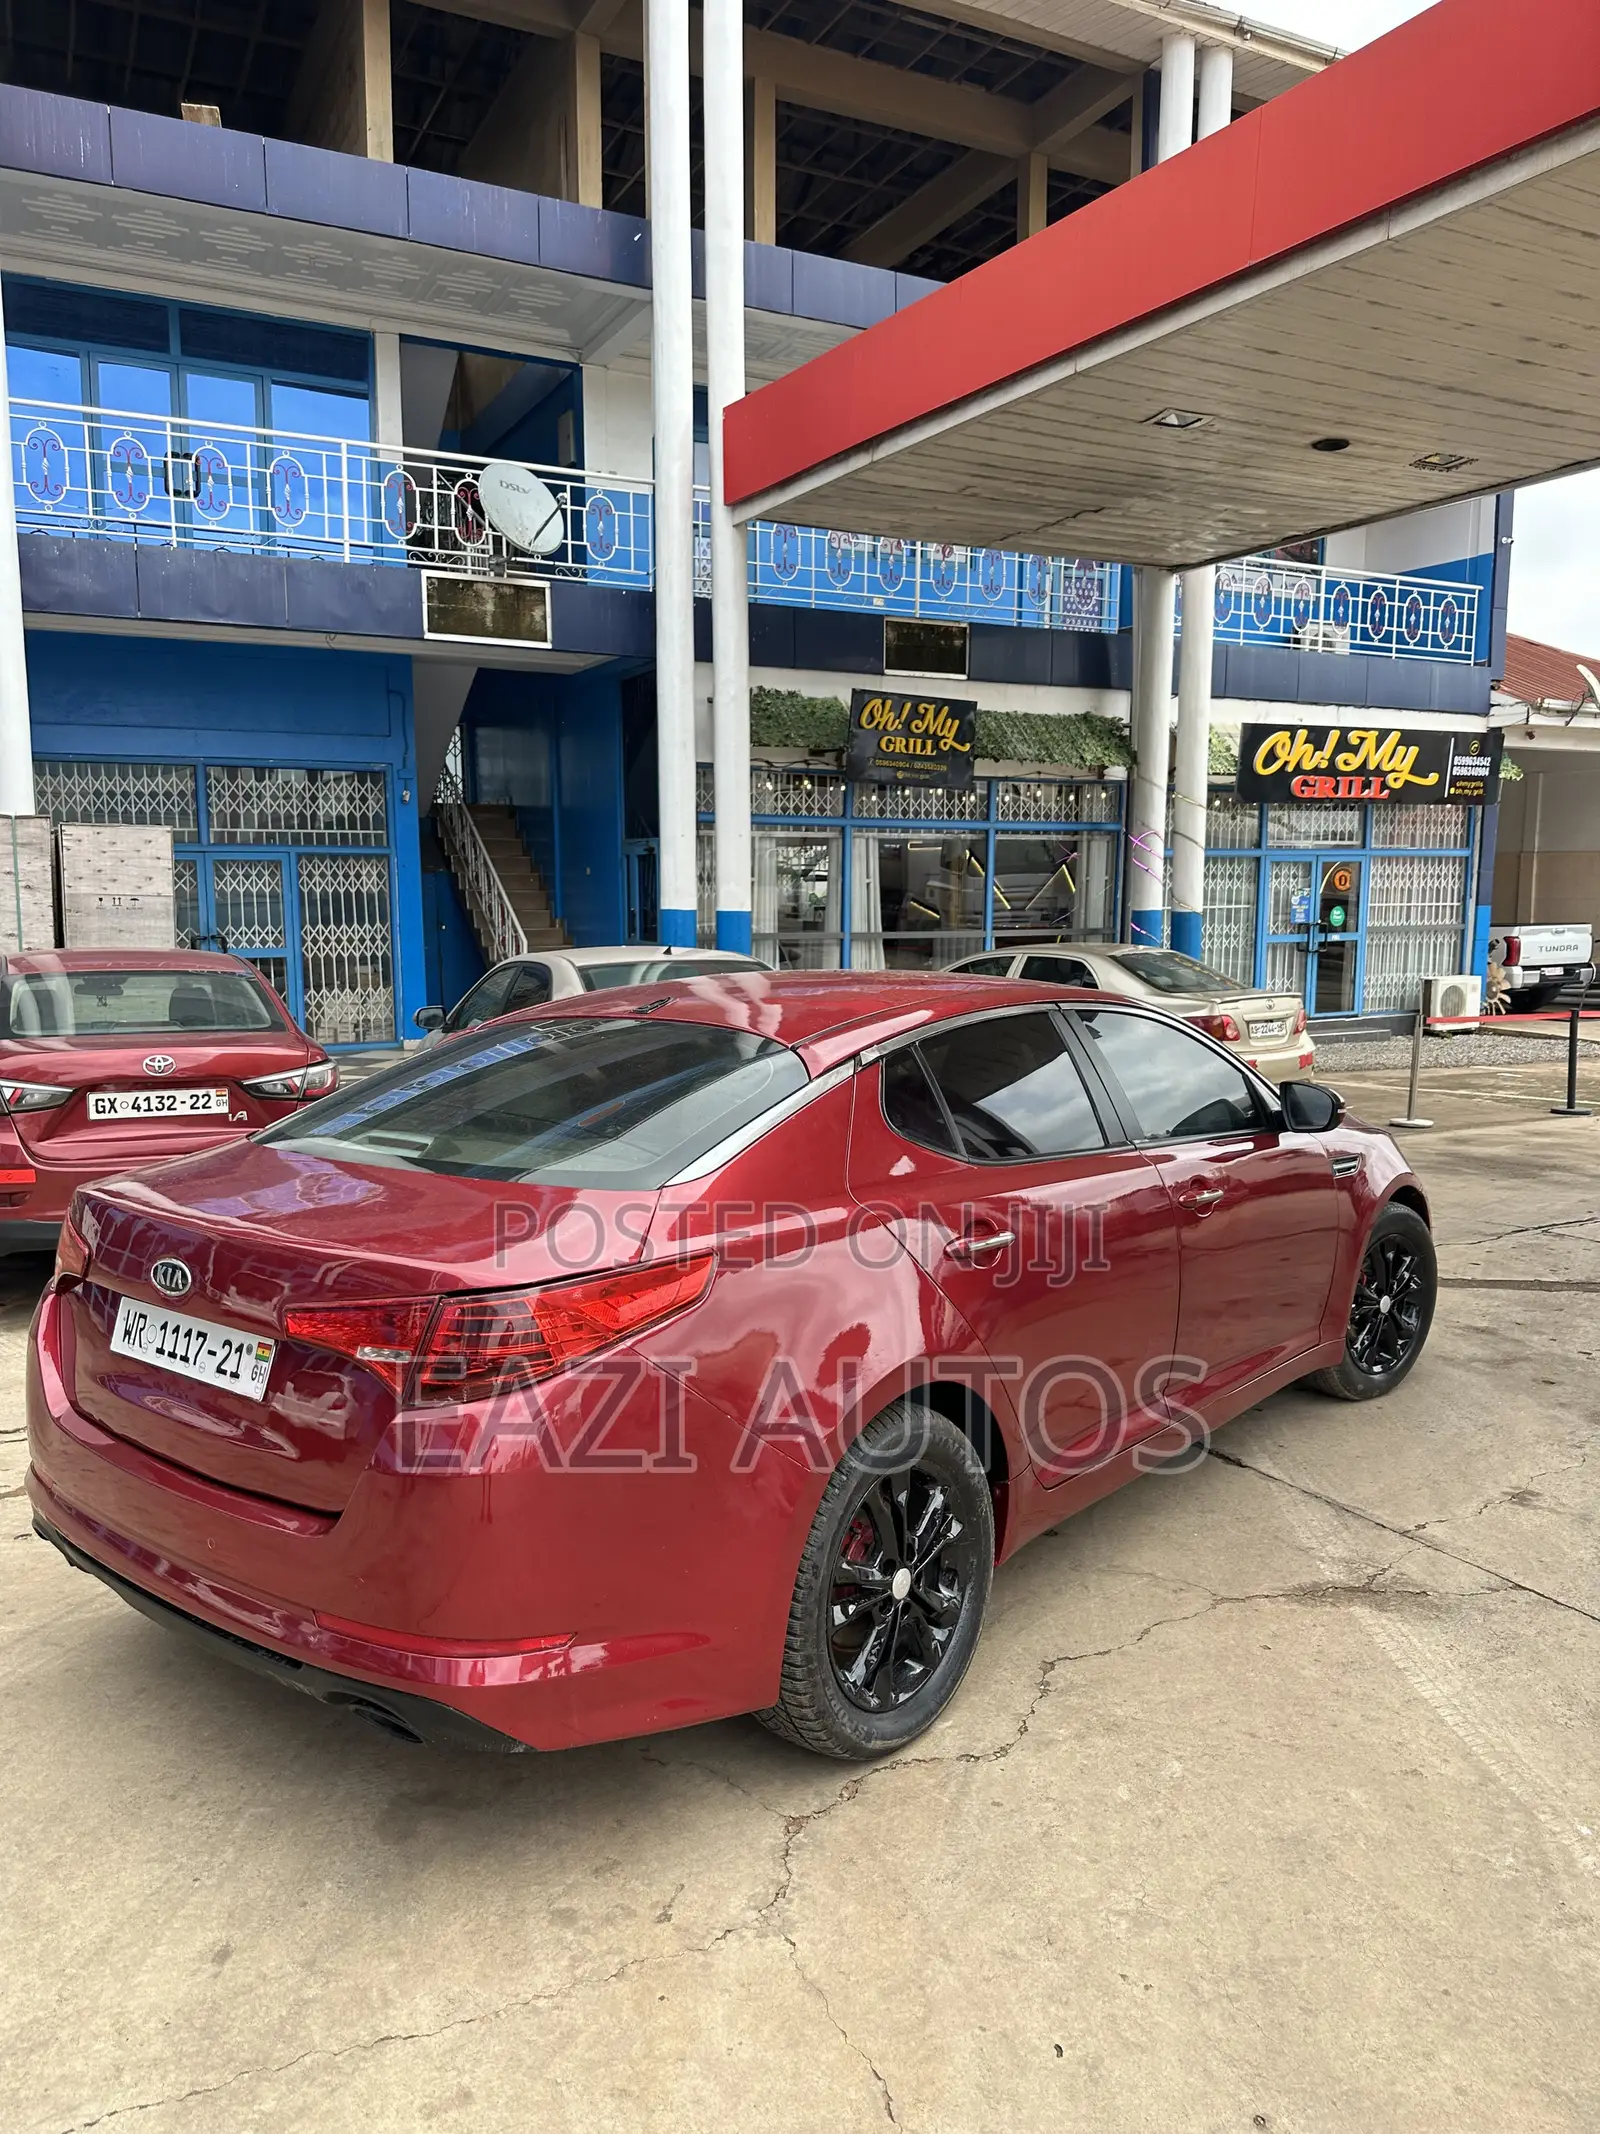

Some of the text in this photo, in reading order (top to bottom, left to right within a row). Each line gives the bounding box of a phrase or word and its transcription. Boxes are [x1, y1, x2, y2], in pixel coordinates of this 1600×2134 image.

[858, 697, 971, 752] Oh! My
[879, 735, 937, 756] GRILL
[1252, 728, 1440, 789] Oh! My
[1290, 774, 1391, 800] GRILL
[1538, 944, 1579, 953] TUNDRA
[94, 1093, 228, 1115] GX 4132-22 GH
[156, 1264, 184, 1290] KIA
[122, 1308, 267, 1384] WR 1117-21 GH
